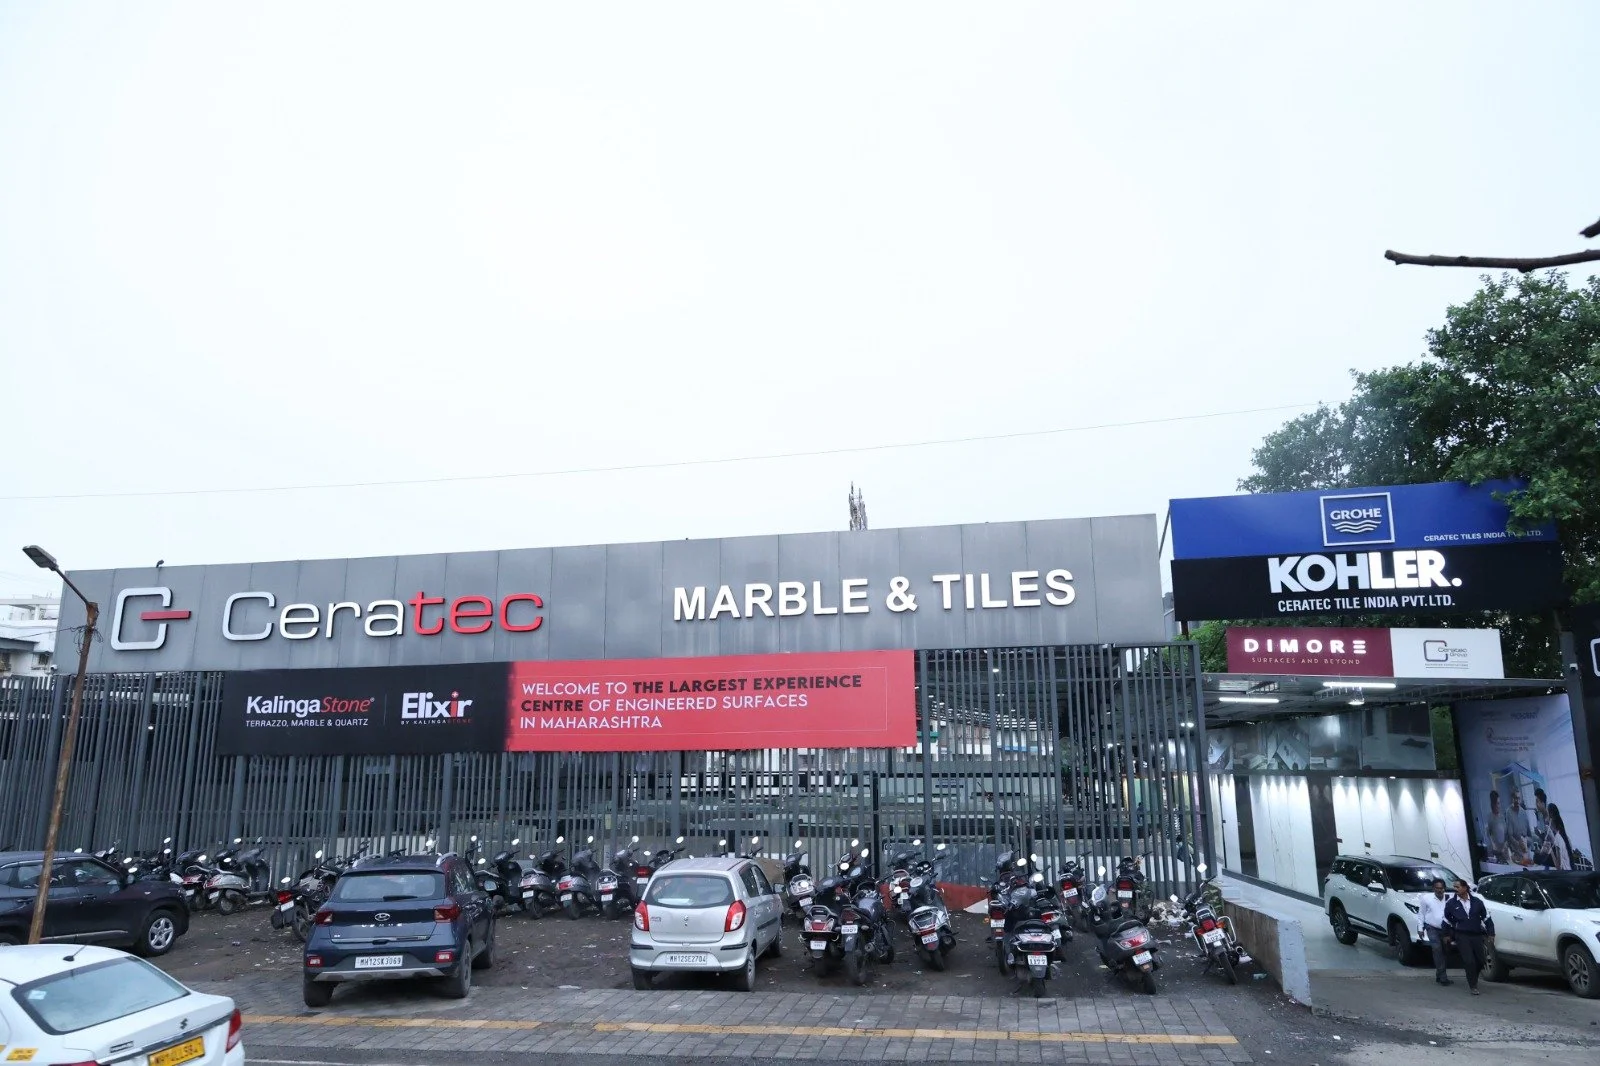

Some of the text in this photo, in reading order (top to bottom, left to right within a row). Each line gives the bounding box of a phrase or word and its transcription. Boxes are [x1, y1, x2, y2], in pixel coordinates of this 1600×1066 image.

[1330, 507, 1382, 520] GROHE
[1423, 534, 1459, 542] CERATEC
[1460, 532, 1482, 540] TILES
[1483, 531, 1506, 539] INDIA
[673, 568, 1077, 621] MARBLE & TILES
[1278, 598, 1331, 612] CERATEC
[1334, 597, 1360, 610] TILE
[1364, 595, 1398, 608] INDIA
[222, 591, 544, 641] Ceratec
[521, 674, 862, 695] WELCOME TO THE LARGEST EXPERIENCE
[401, 691, 473, 719] Elixir
[521, 694, 808, 712] CENTRE OF ENGINEERED SURFACES
[246, 718, 369, 728] TERRAZZO, MARBLE & QUARTZ
[520, 716, 663, 729] IN MAHARASHTRA
[360, 955, 401, 966] MH12SK3069
[669, 955, 706, 963] MH12SE2704
